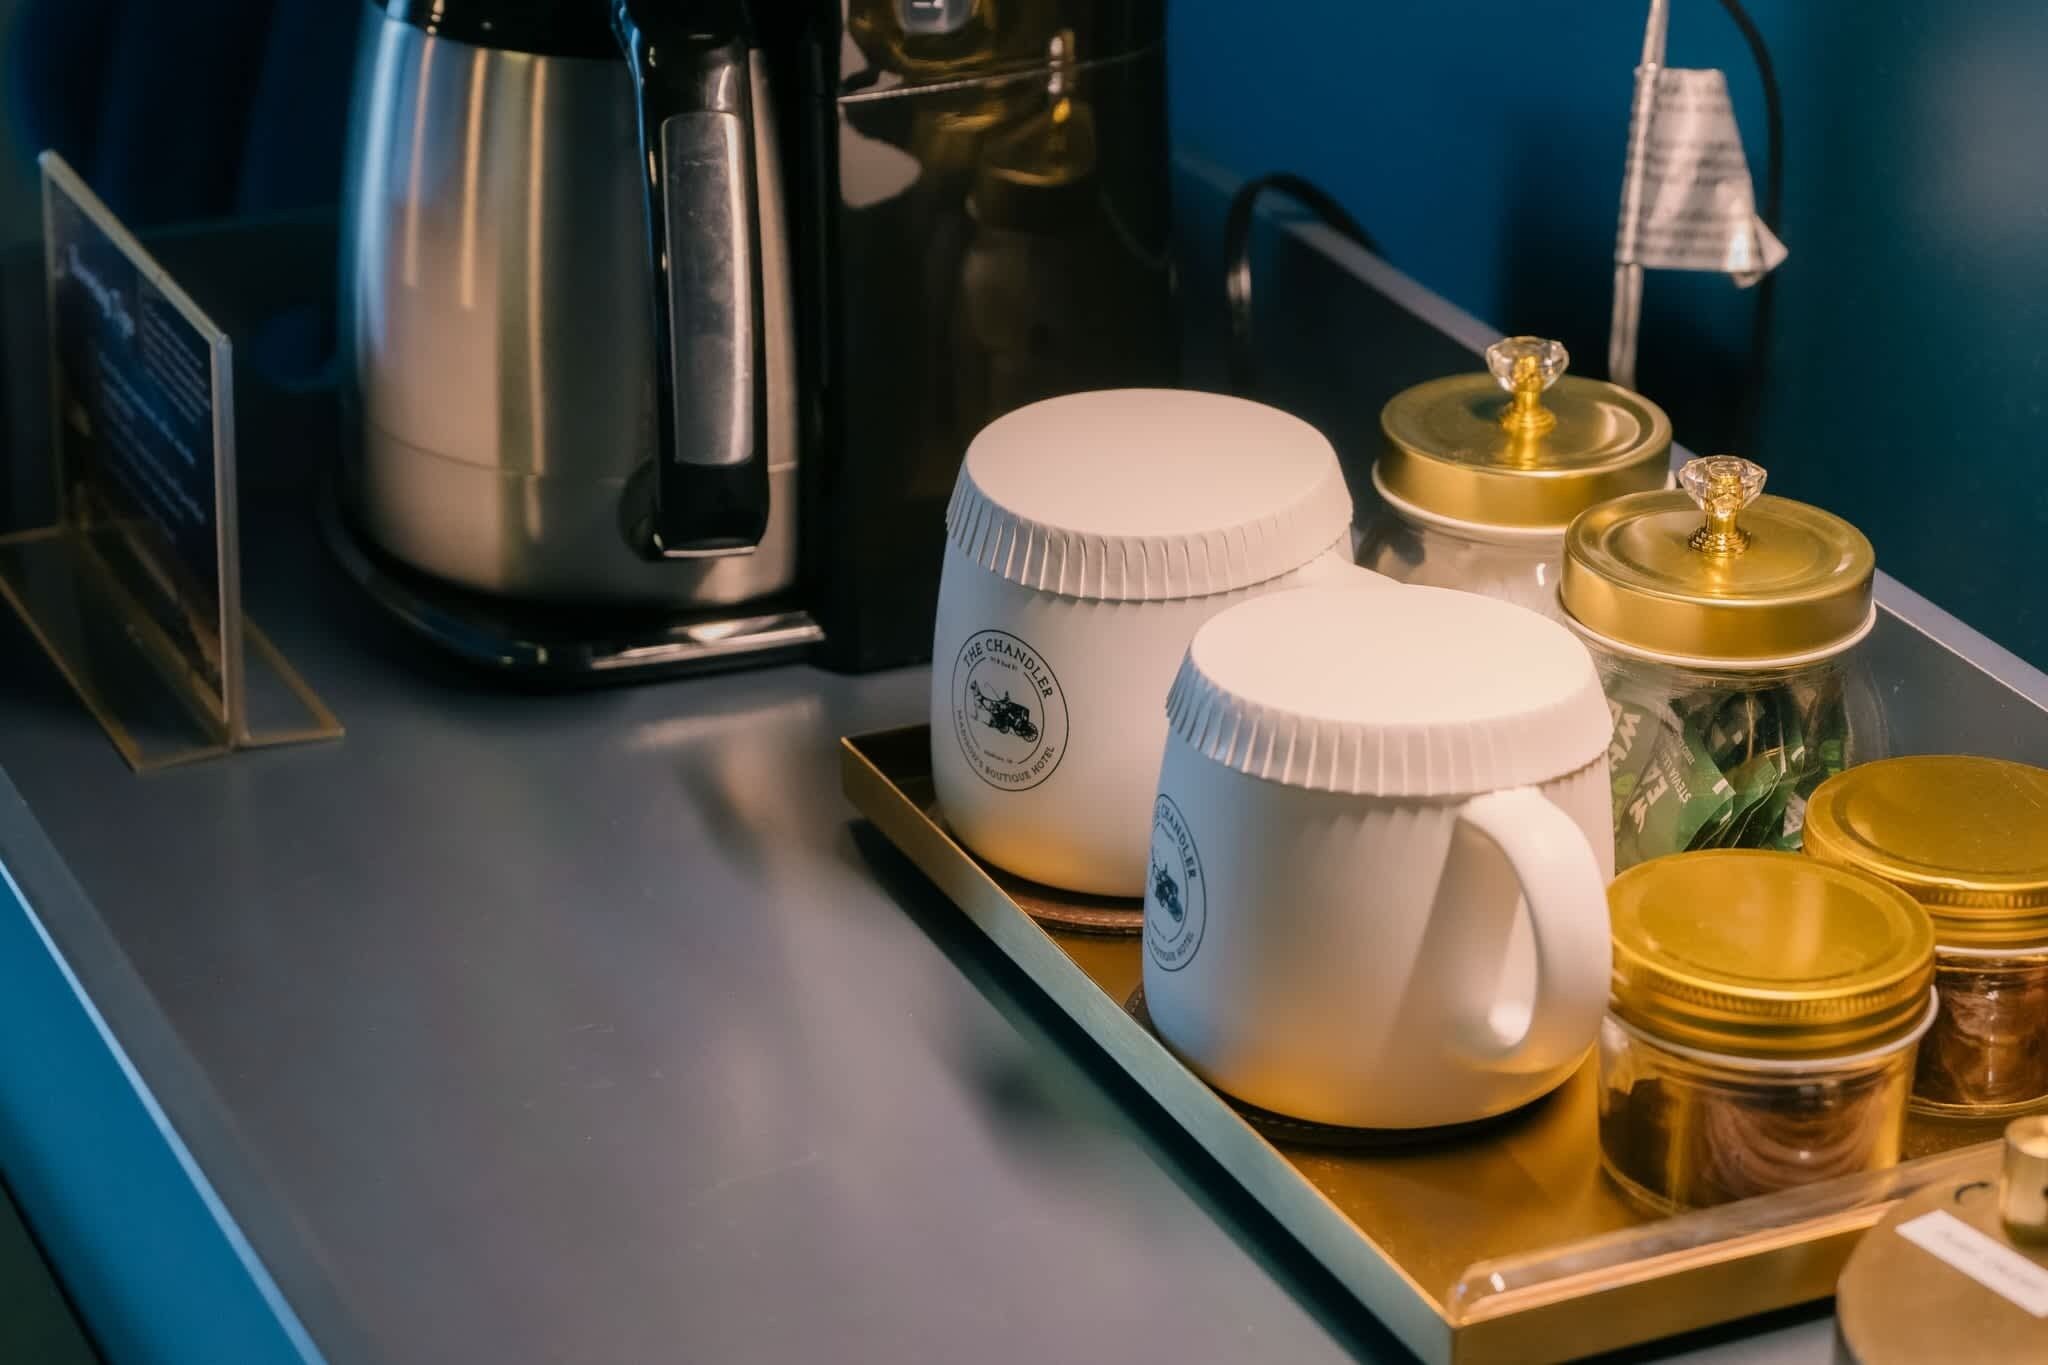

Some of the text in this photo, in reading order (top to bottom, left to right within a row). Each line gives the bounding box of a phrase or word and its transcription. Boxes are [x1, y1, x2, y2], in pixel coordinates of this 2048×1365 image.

[963, 638, 1053, 699] THE CHANDLER
[985, 765, 1031, 783] BOUTIQUE
[1031, 746, 1055, 775] HOTEL
